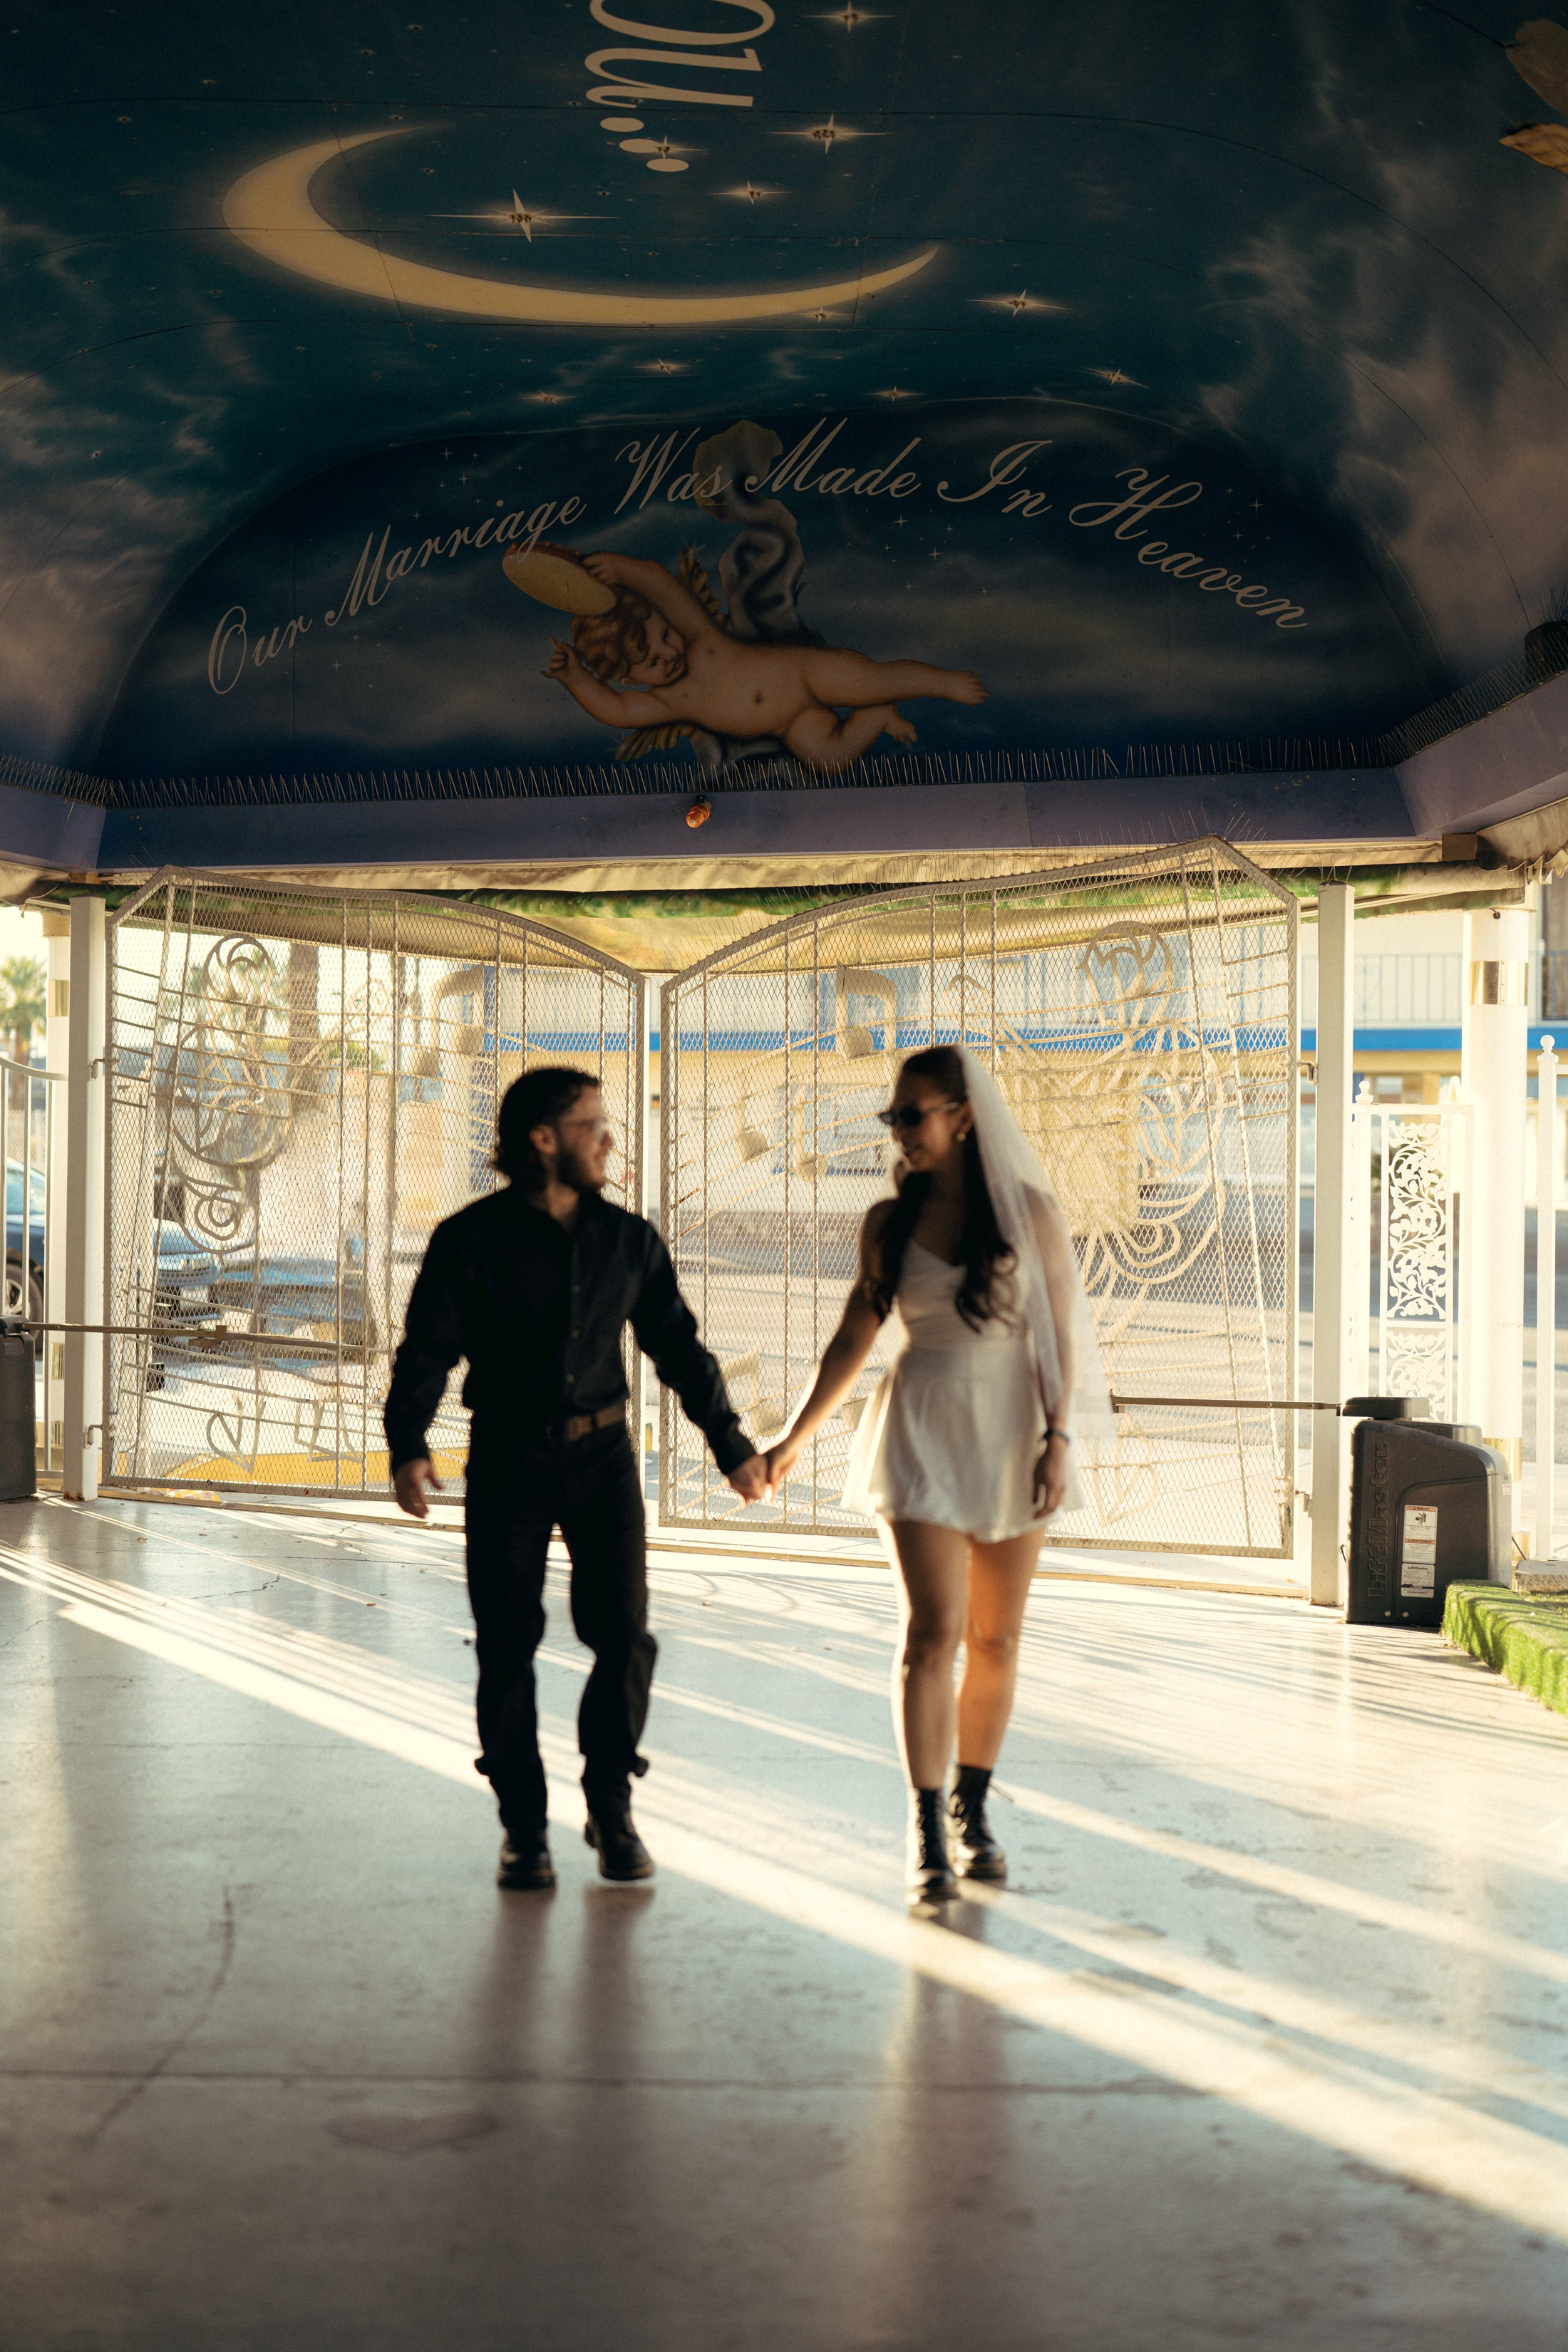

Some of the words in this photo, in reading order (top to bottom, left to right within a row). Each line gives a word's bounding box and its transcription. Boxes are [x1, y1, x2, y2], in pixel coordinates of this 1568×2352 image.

[207, 605, 312, 695] Our
[324, 495, 587, 619] Marriage
[614, 427, 733, 515] Was
[745, 416, 922, 498] Made
[937, 439, 1053, 518] In
[1068, 468, 1309, 629] Heaven
[1367, 1442, 1390, 1598] LiftMaster
